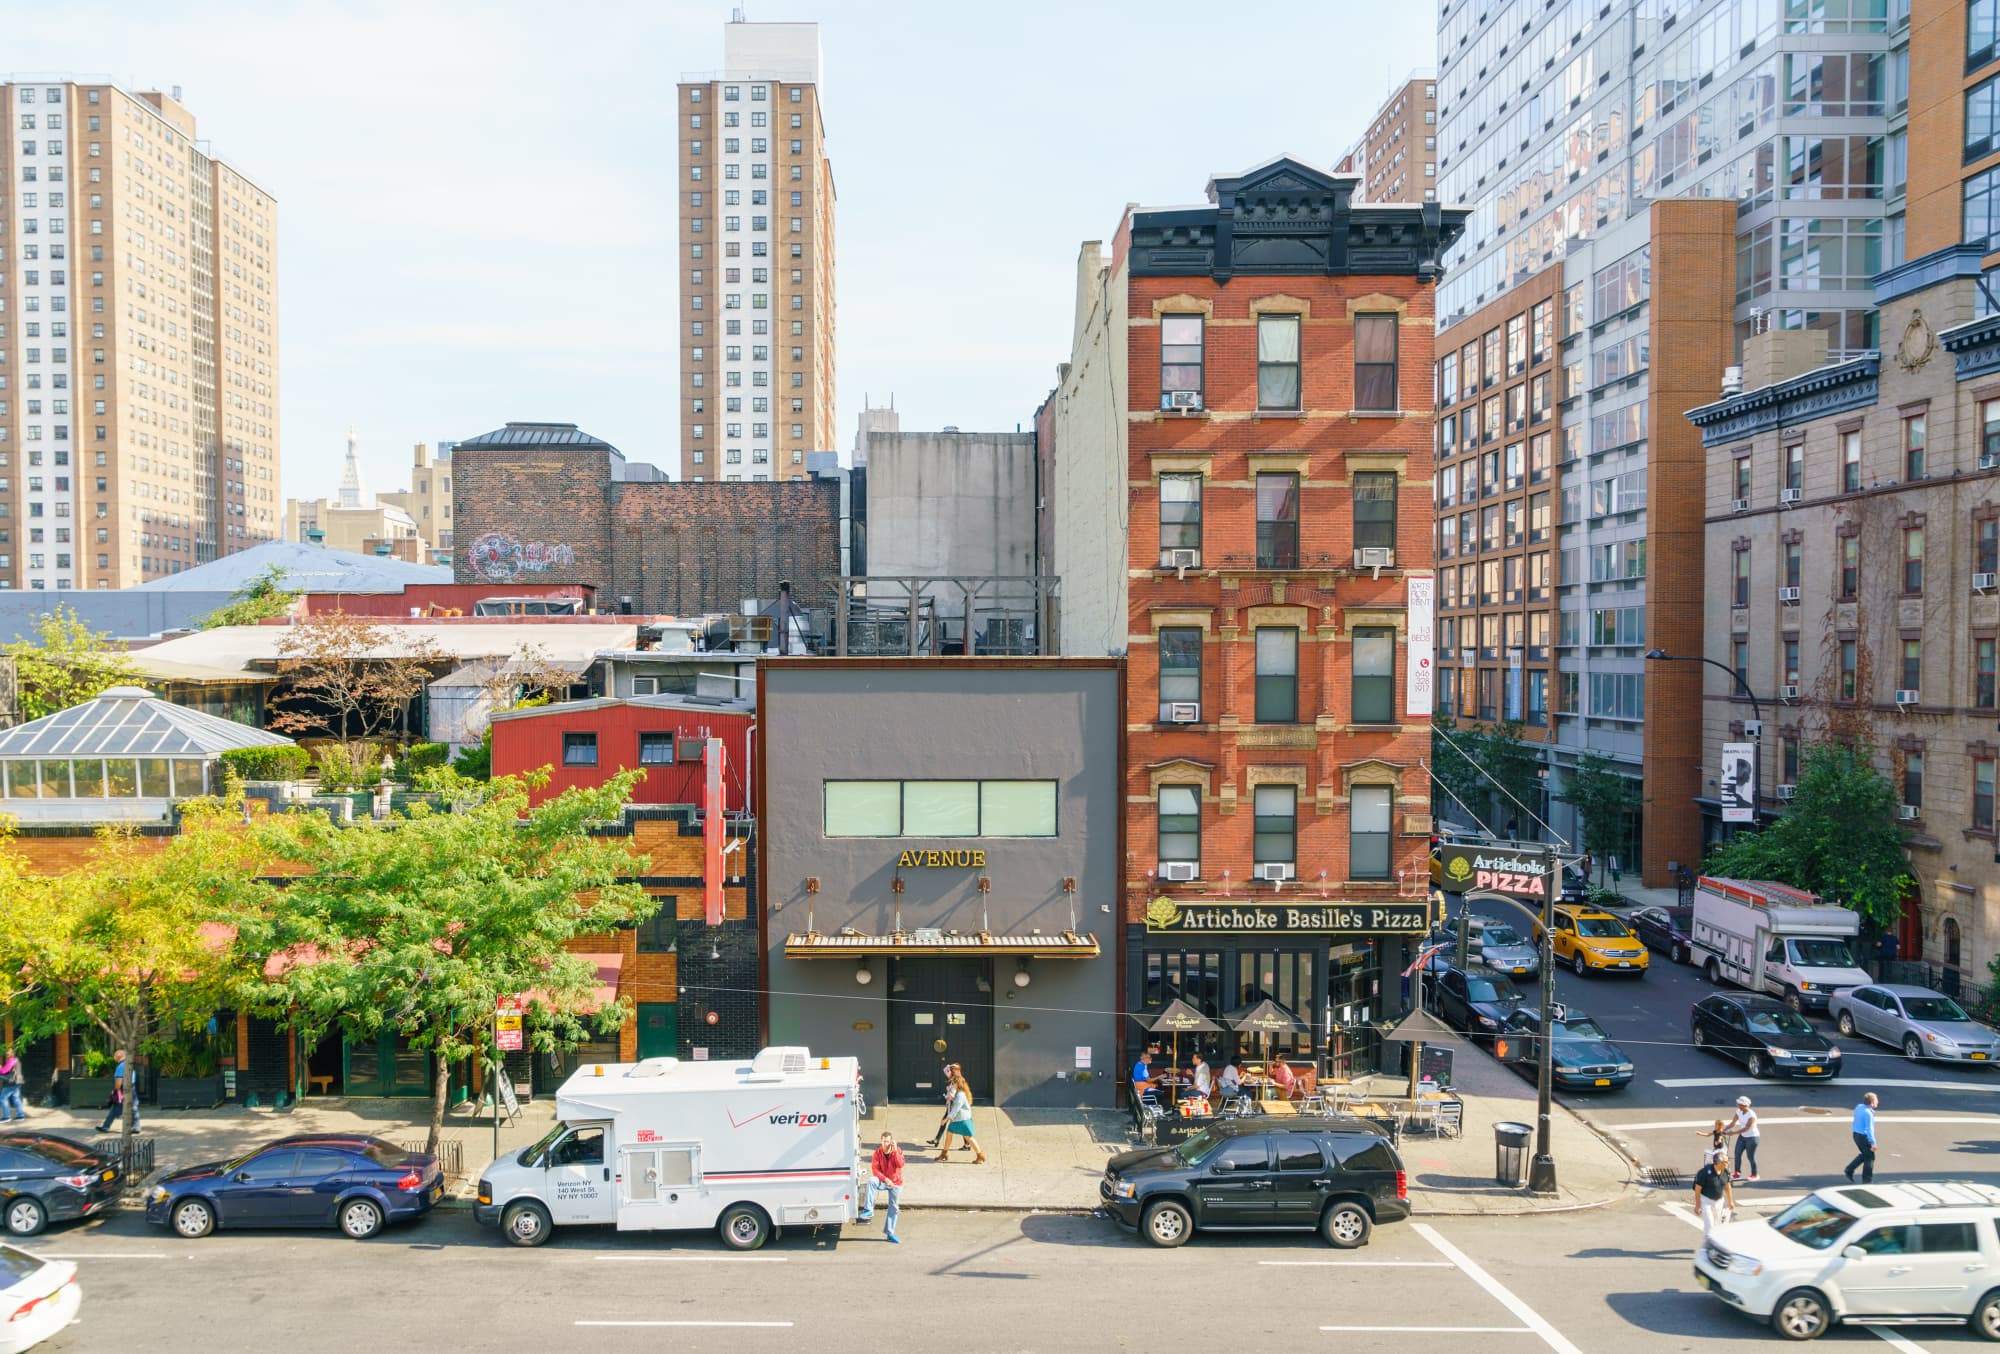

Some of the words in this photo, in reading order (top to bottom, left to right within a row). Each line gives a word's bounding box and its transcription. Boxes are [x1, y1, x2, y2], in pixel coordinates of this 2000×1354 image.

[897, 850, 986, 867] AVENUE
[1476, 870, 1545, 895] PIZZA
[1183, 909, 1278, 929] Artichoke
[1286, 909, 1363, 929] Basille's
[1371, 909, 1424, 929] Pizza
[769, 1112, 827, 1127] verizon
